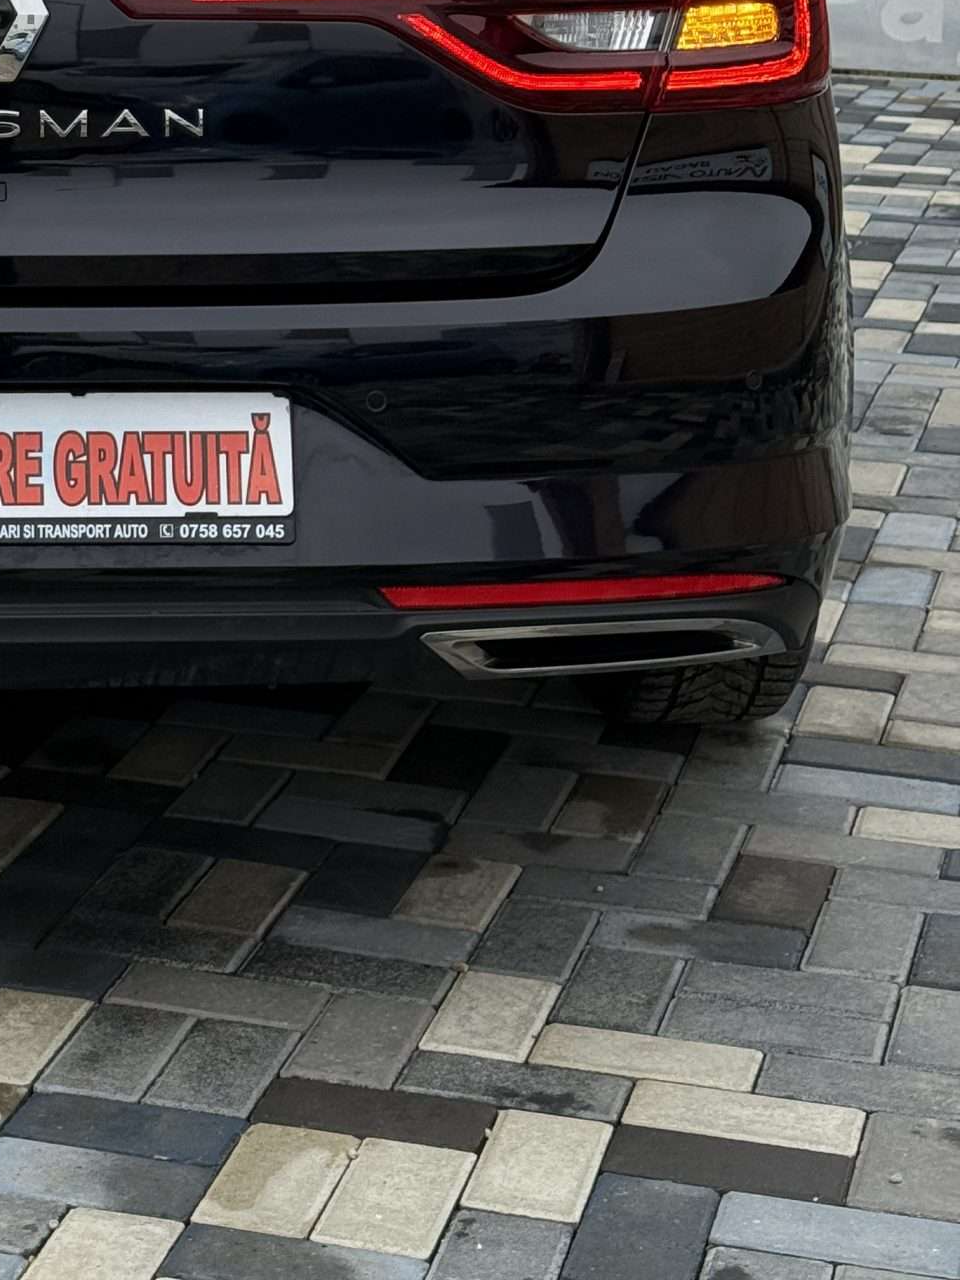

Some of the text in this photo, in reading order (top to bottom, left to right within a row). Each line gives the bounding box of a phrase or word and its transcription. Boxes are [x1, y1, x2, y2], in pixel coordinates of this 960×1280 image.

[53, 412, 282, 506] GRATUITĂ
[23, 524, 35, 539] SI
[39, 524, 111, 539] TRANSPORT
[113, 524, 148, 539] AUTO
[179, 524, 218, 538] 0758
[222, 524, 251, 538] 657
[255, 524, 285, 538] 045
